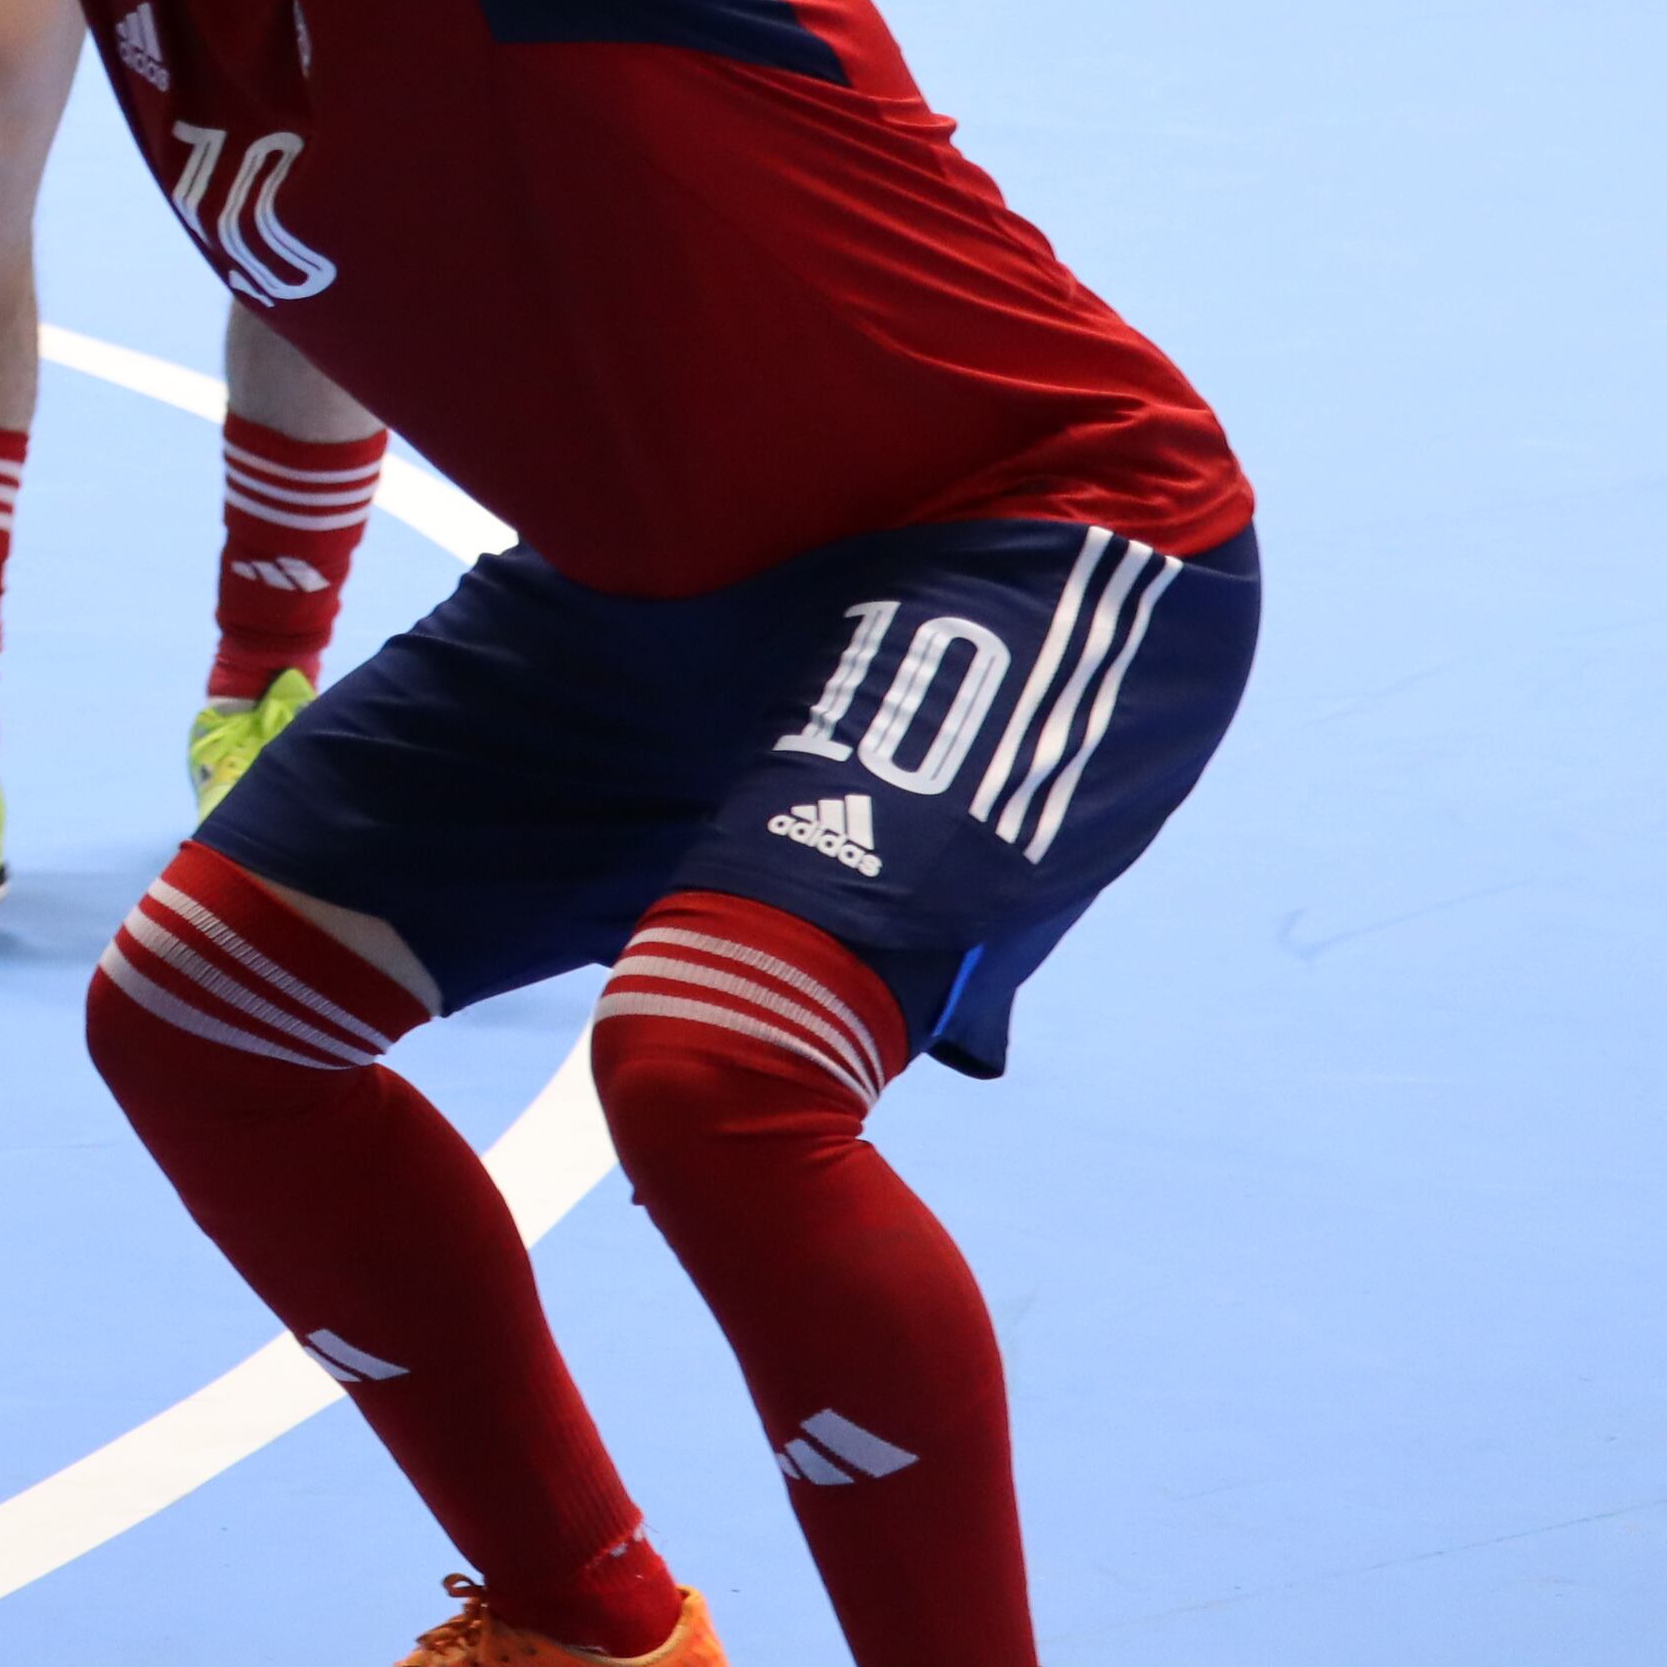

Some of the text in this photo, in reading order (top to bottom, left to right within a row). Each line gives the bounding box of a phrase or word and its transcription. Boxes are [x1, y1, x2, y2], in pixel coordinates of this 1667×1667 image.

[171, 120, 336, 307] 10
[772, 600, 1011, 795] 10
[767, 814, 883, 877] adidas
